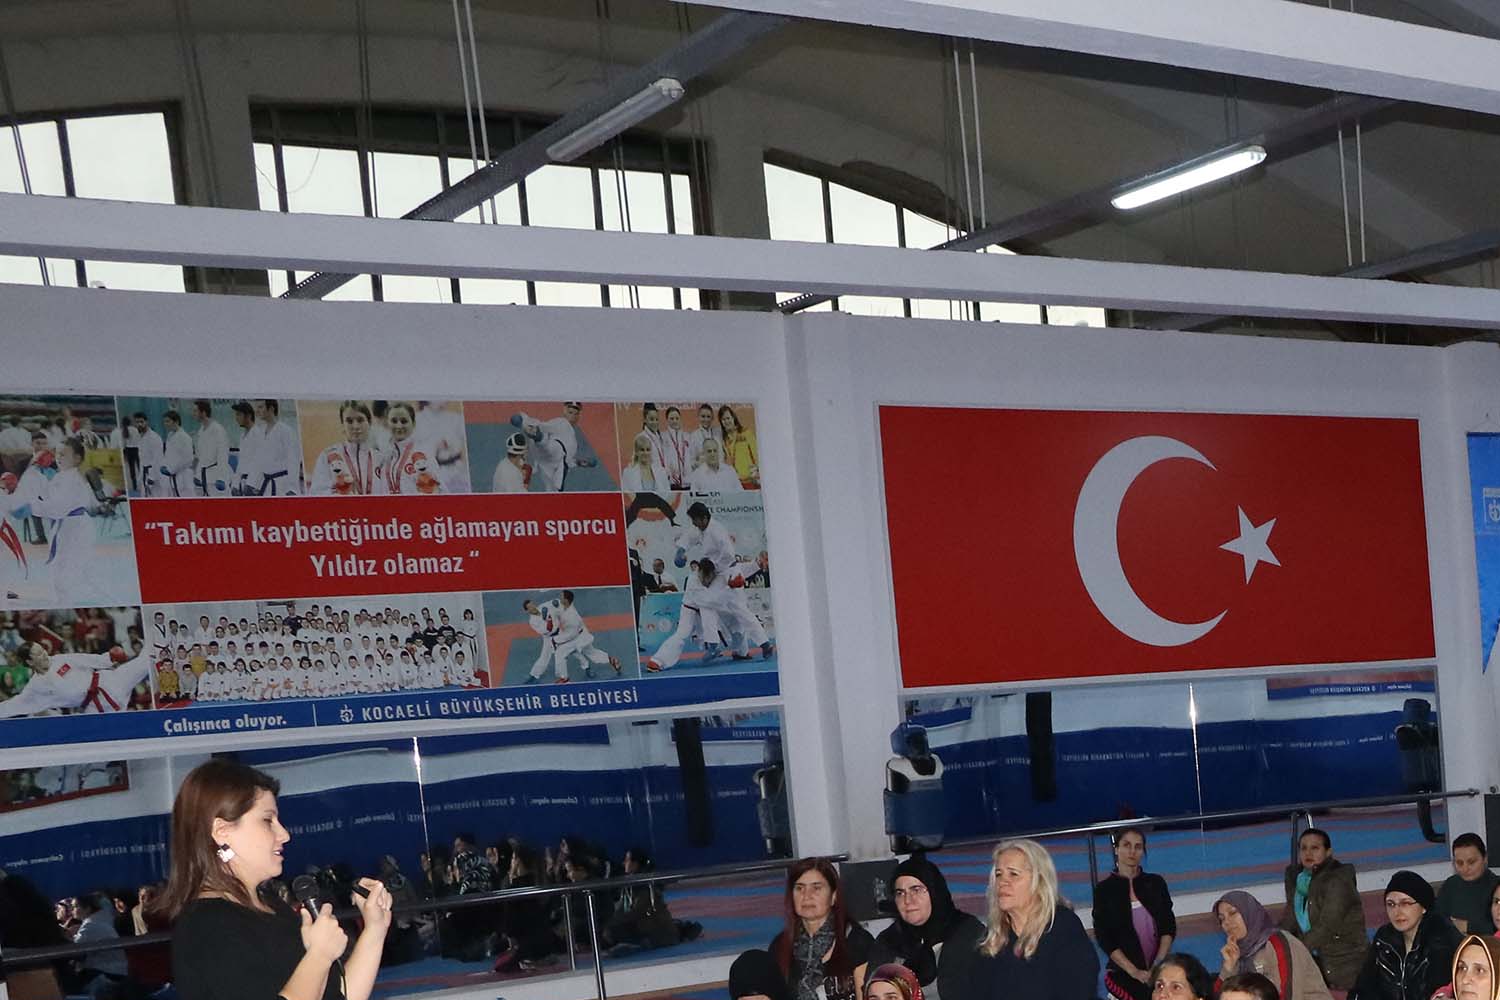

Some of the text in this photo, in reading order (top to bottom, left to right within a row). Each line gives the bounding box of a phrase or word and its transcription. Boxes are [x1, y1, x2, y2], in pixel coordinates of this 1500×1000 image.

[144, 515, 617, 548] “Takımı kaybettiğinde ağlamayan sporcu
[309, 553, 378, 577] Yıldız
[383, 552, 465, 576] olamaz
[362, 685, 639, 721] KOCAELİ BÜYÜKŞEHİR BELEDİYESİ
[163, 713, 287, 736] Çalışınca oluyor.
